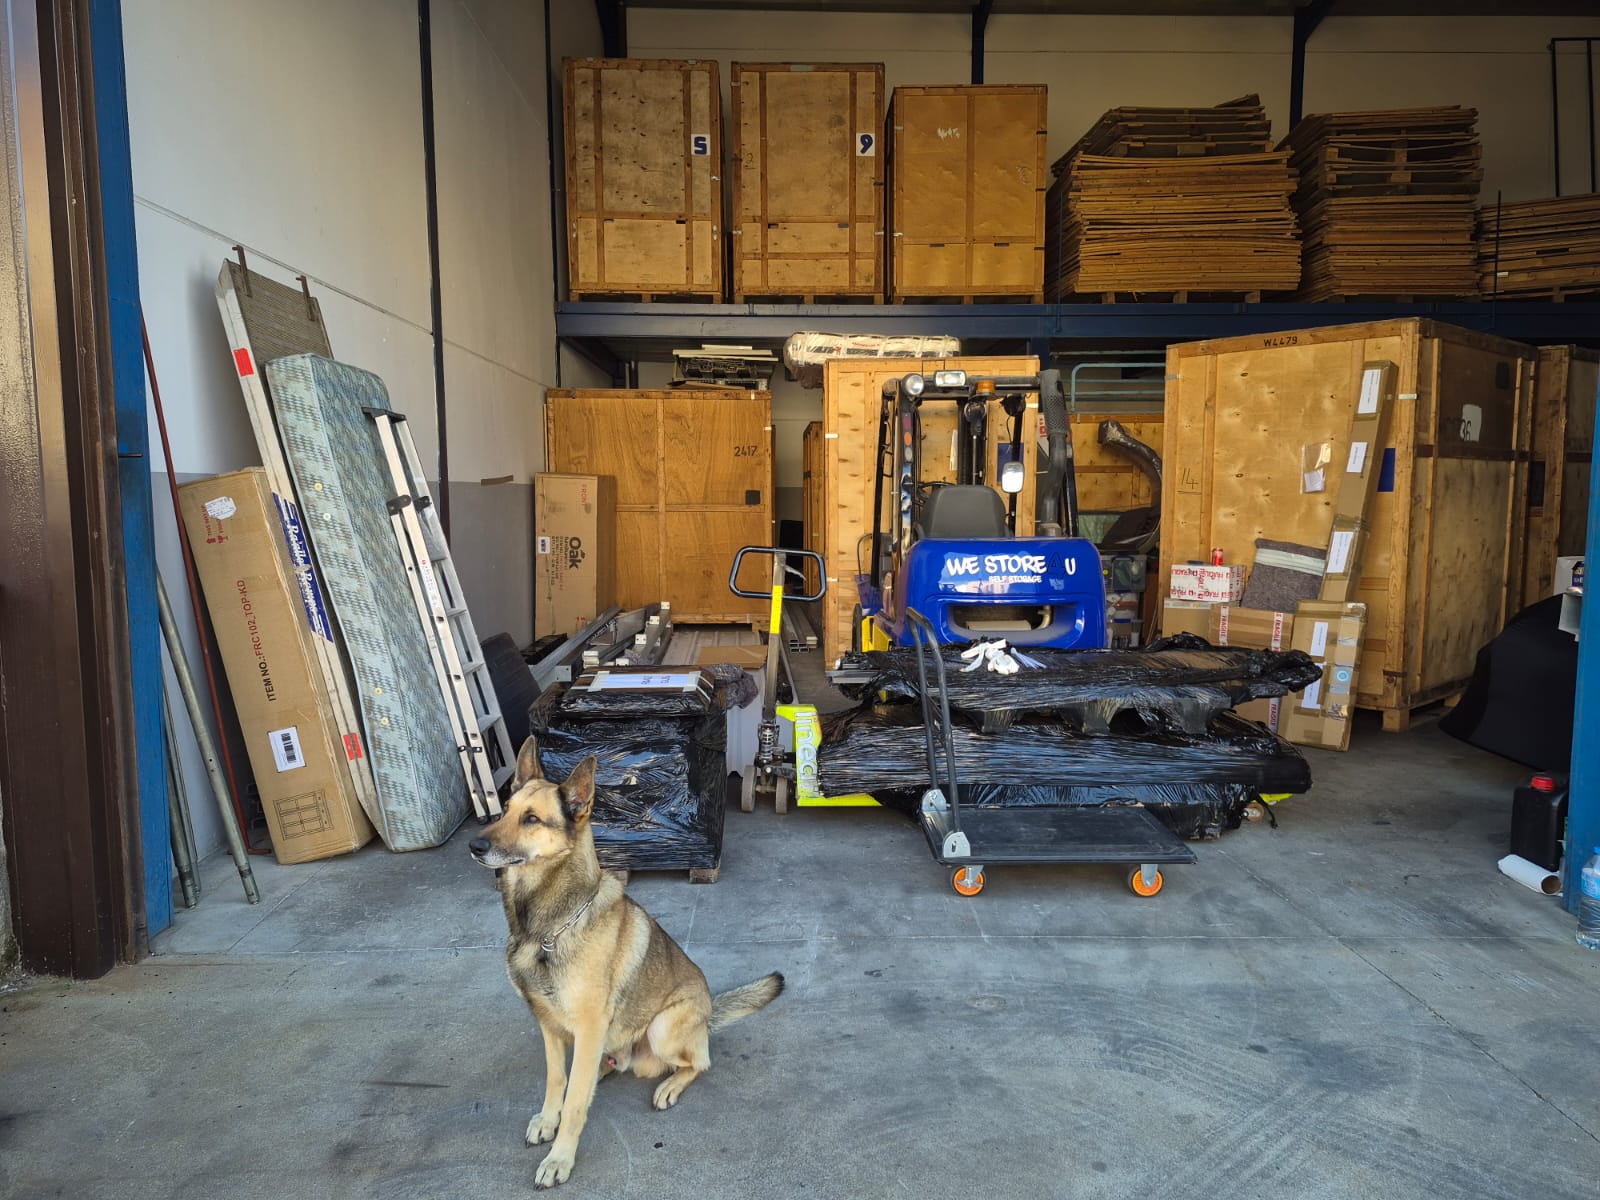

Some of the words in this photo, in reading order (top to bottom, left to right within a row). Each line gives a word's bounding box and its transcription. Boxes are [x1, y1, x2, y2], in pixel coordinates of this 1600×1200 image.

[859, 134, 874, 154] 9
[733, 445, 759, 458] 2417
[568, 536, 582, 569] Oak
[946, 555, 980, 577] WE
[984, 554, 1047, 574] STORE
[988, 575, 1007, 584] SELF
[1008, 575, 1042, 584] STORAGE
[1273, 619, 1282, 643] FRAGILE
[262, 677, 277, 702] ITEM
